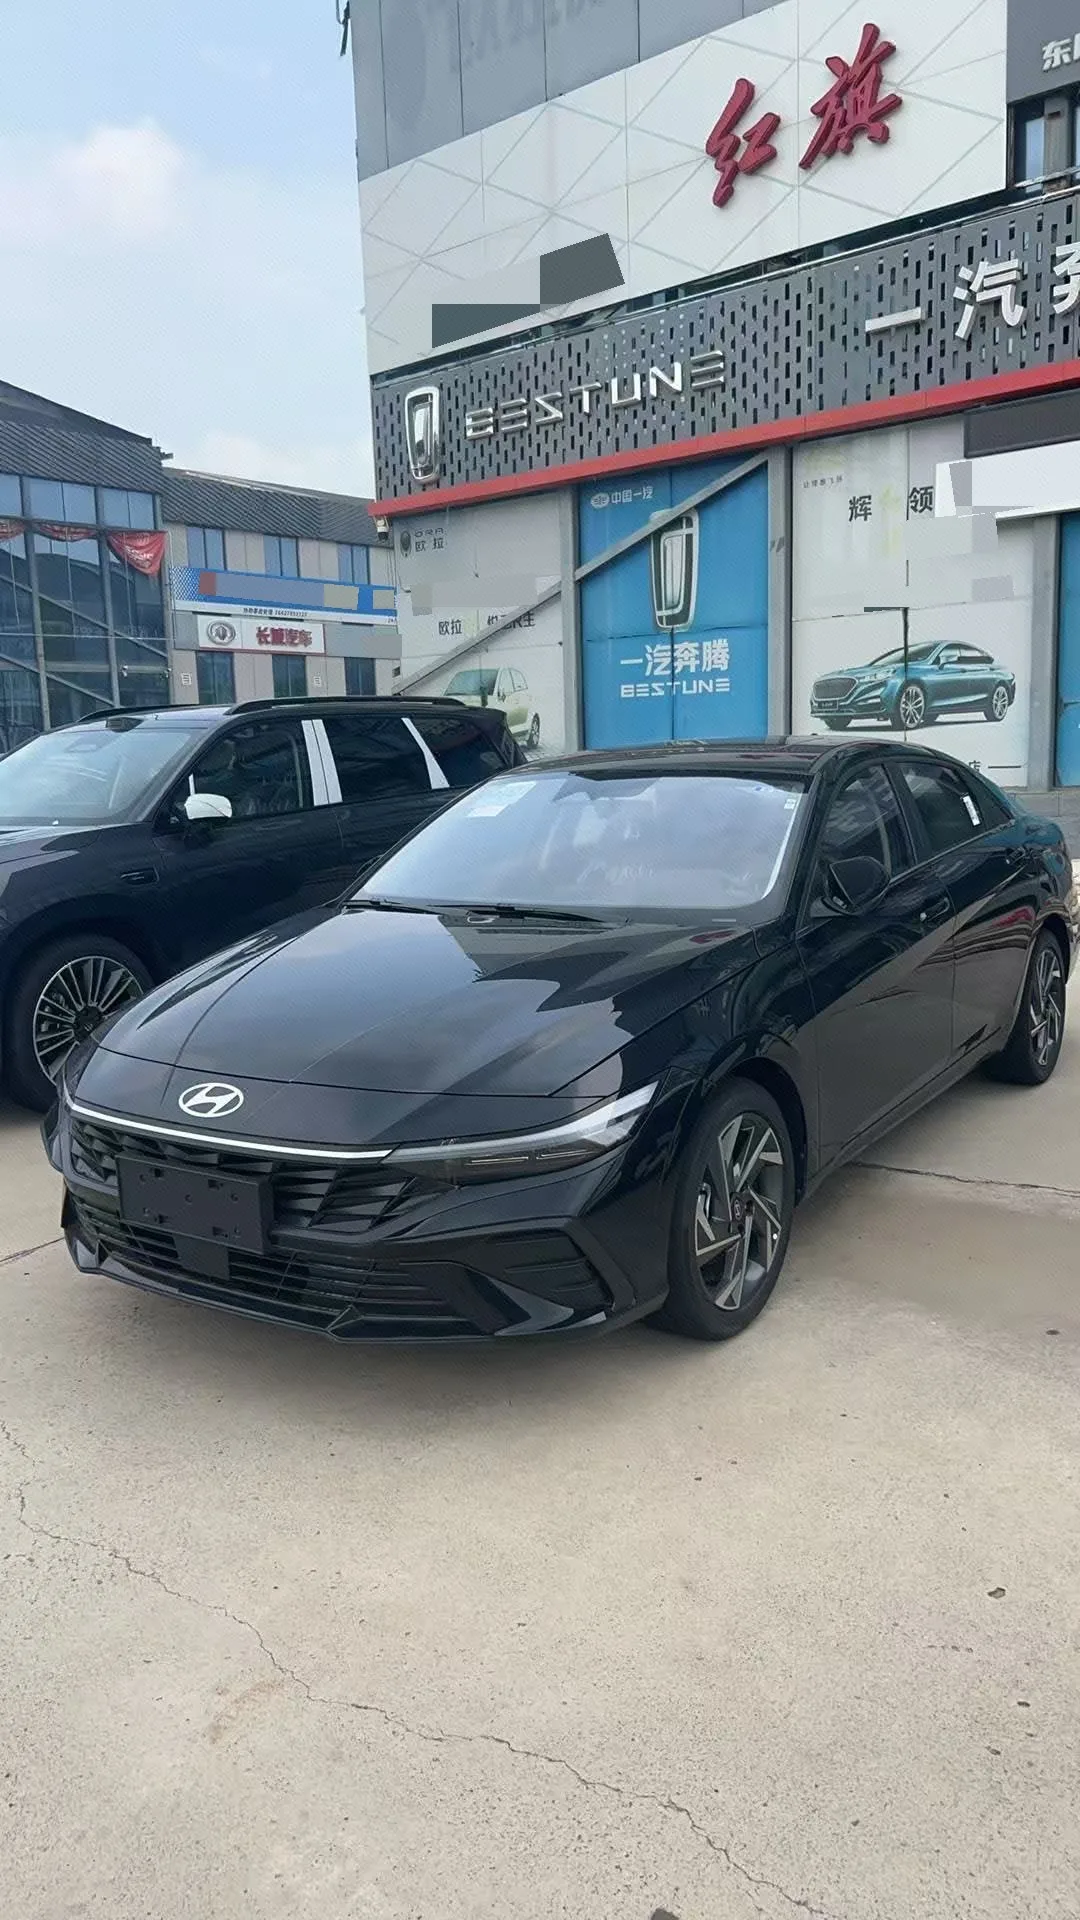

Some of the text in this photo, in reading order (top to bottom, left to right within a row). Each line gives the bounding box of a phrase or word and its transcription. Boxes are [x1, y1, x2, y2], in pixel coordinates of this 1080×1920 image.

[1042, 33, 1080, 70] 东
[706, 23, 902, 208] 红旗
[465, 350, 725, 441] BESTUNE
[611, 485, 654, 505] 中国一汽
[415, 537, 444, 552] 欧拉
[438, 618, 463, 636] 欧拉
[620, 638, 730, 677] 一汽奔腾
[620, 678, 730, 698] BESTUNE
